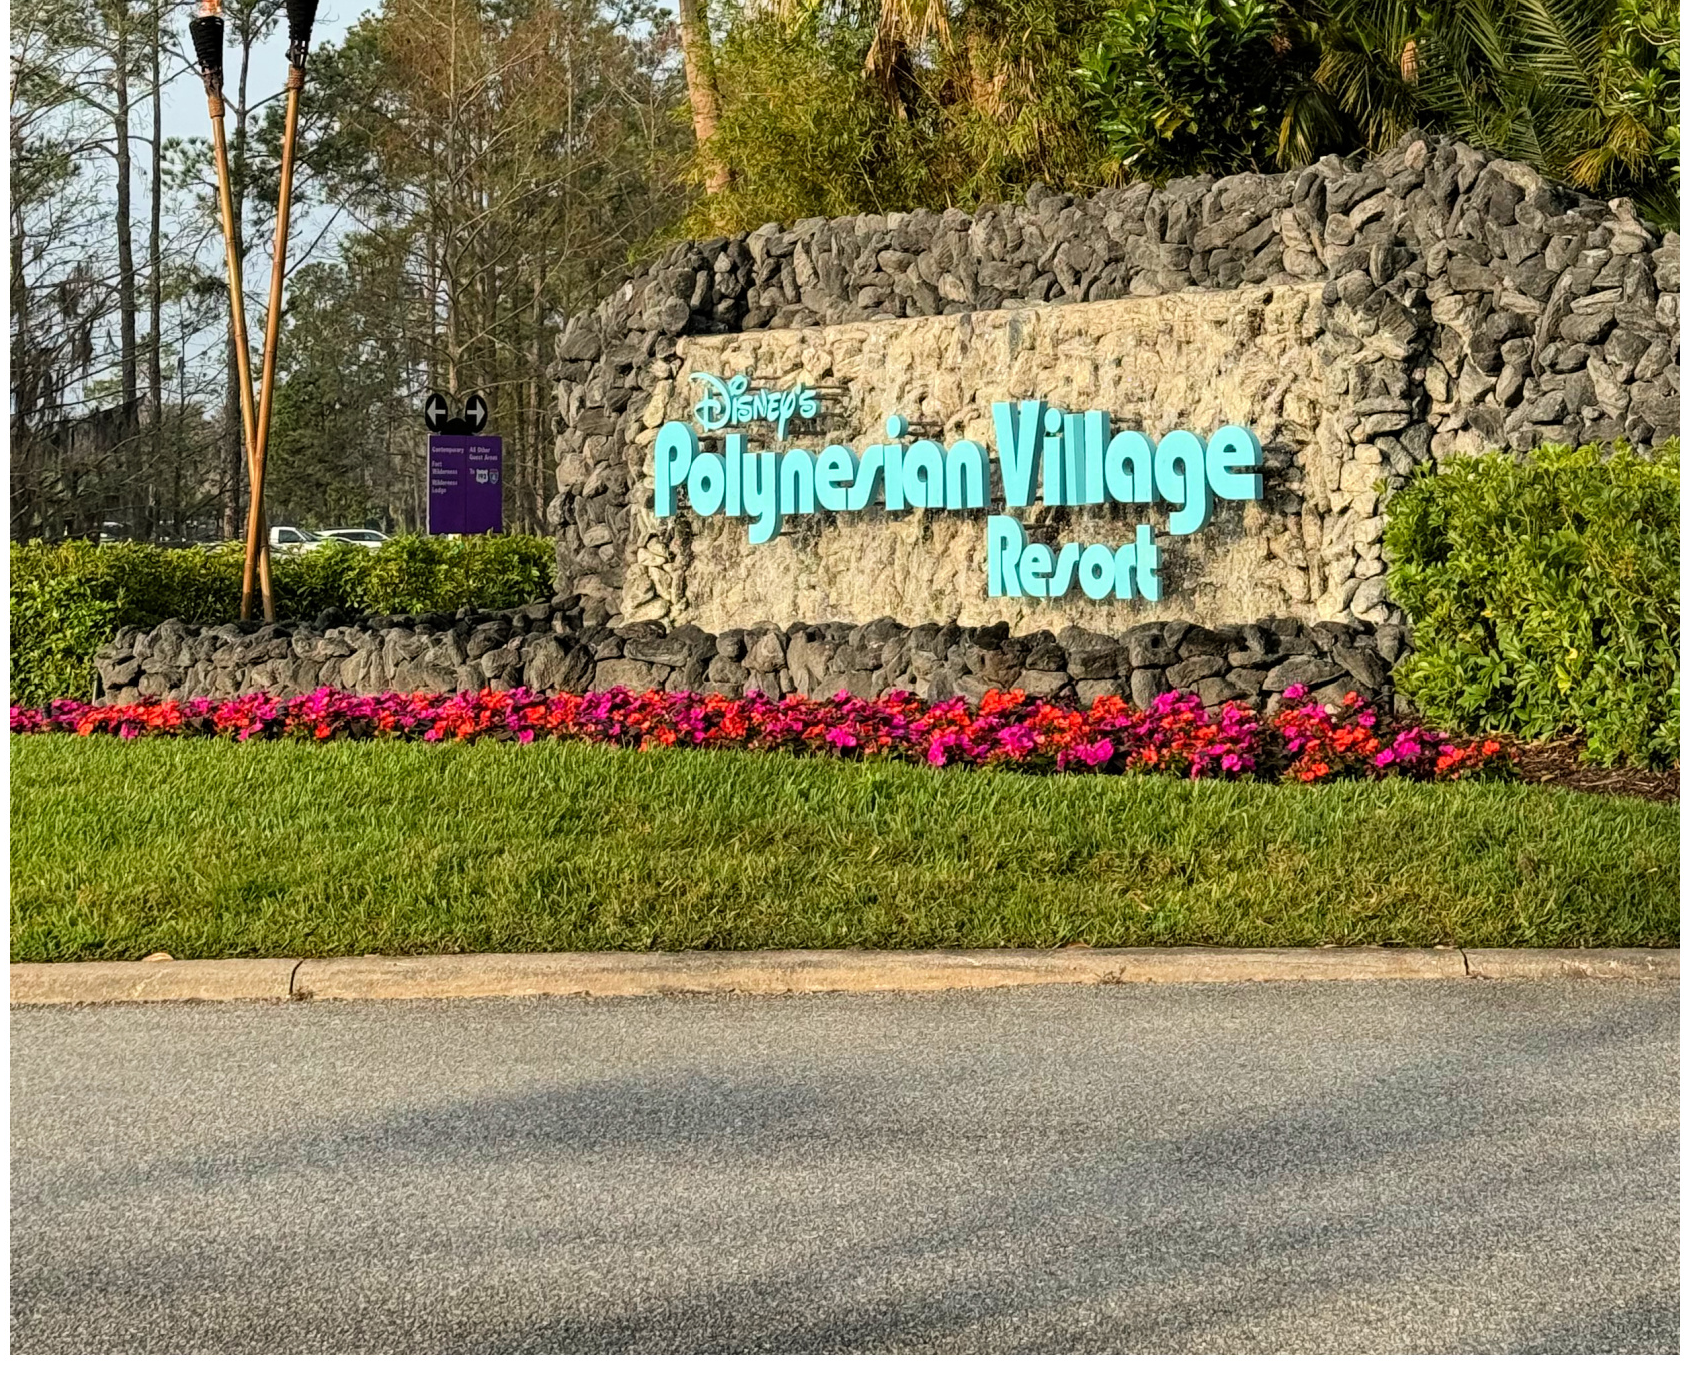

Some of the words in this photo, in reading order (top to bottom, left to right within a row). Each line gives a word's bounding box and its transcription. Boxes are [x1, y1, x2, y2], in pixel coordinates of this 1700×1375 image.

[654, 415, 990, 544] Polynesian
[992, 400, 1263, 535] Village
[988, 515, 1163, 601] Resort
